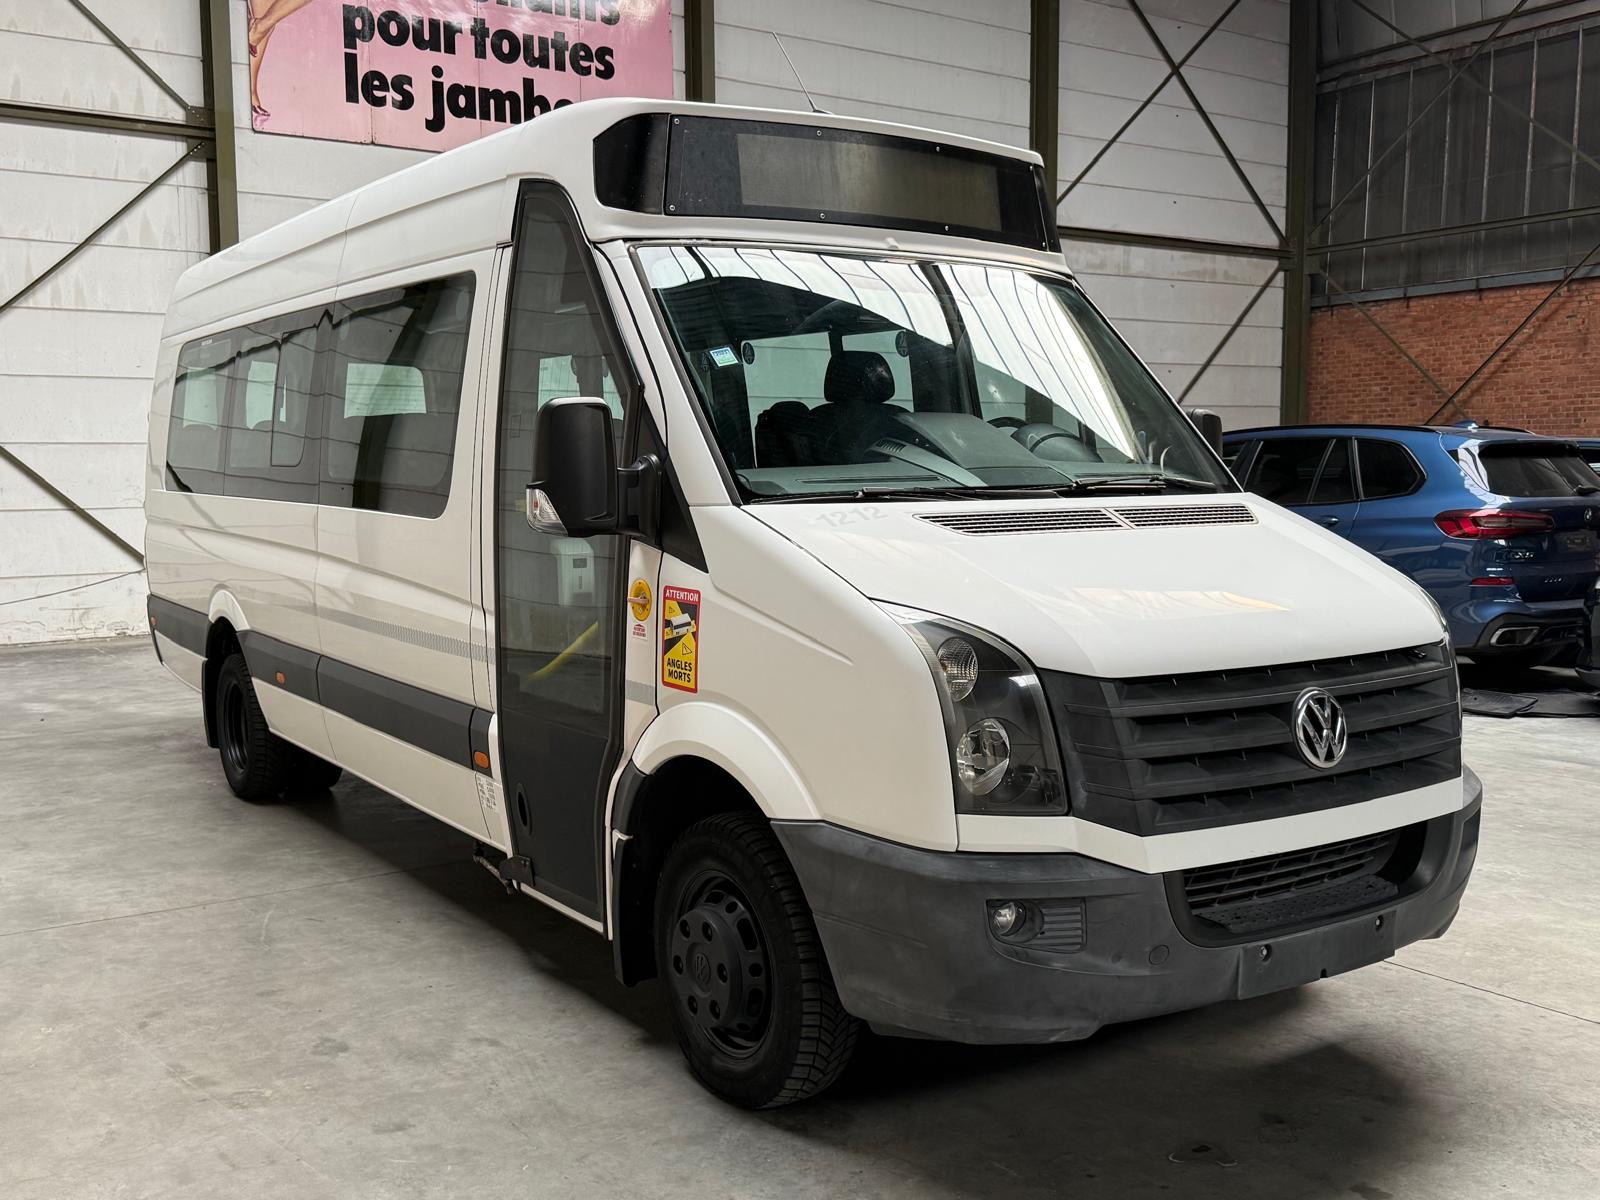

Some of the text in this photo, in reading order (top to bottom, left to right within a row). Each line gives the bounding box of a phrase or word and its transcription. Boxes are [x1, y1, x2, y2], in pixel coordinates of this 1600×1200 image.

[342, 3, 463, 55] pour
[470, 17, 615, 80] toutes
[343, 51, 415, 111] les
[816, 506, 888, 528] 1212
[665, 589, 698, 602] ATTENTION
[666, 658, 692, 672] ANGLES
[668, 669, 691, 683] MORTS
